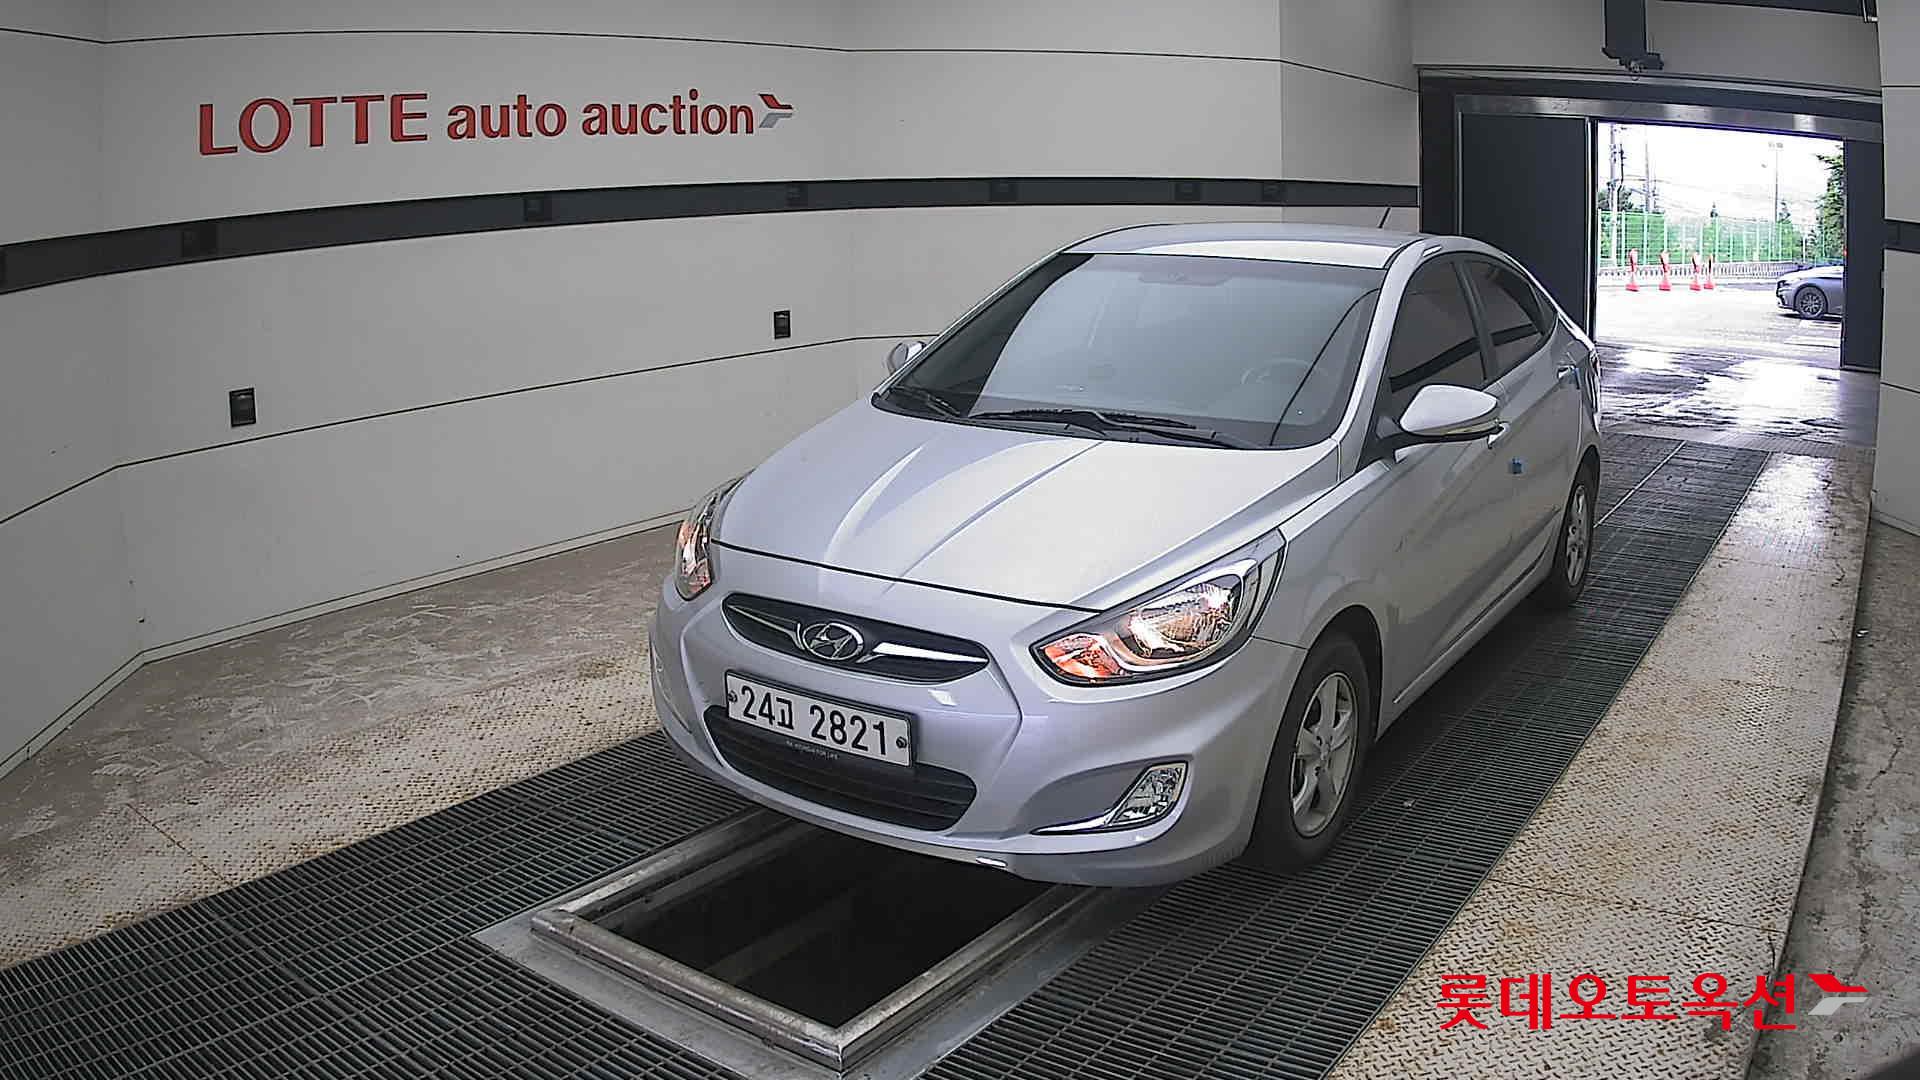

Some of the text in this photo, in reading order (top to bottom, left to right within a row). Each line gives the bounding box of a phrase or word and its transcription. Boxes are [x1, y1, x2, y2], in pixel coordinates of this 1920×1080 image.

[200, 88, 754, 156] LOTTE auto auction
[741, 685, 795, 730] 24고
[809, 704, 887, 756] 2821
